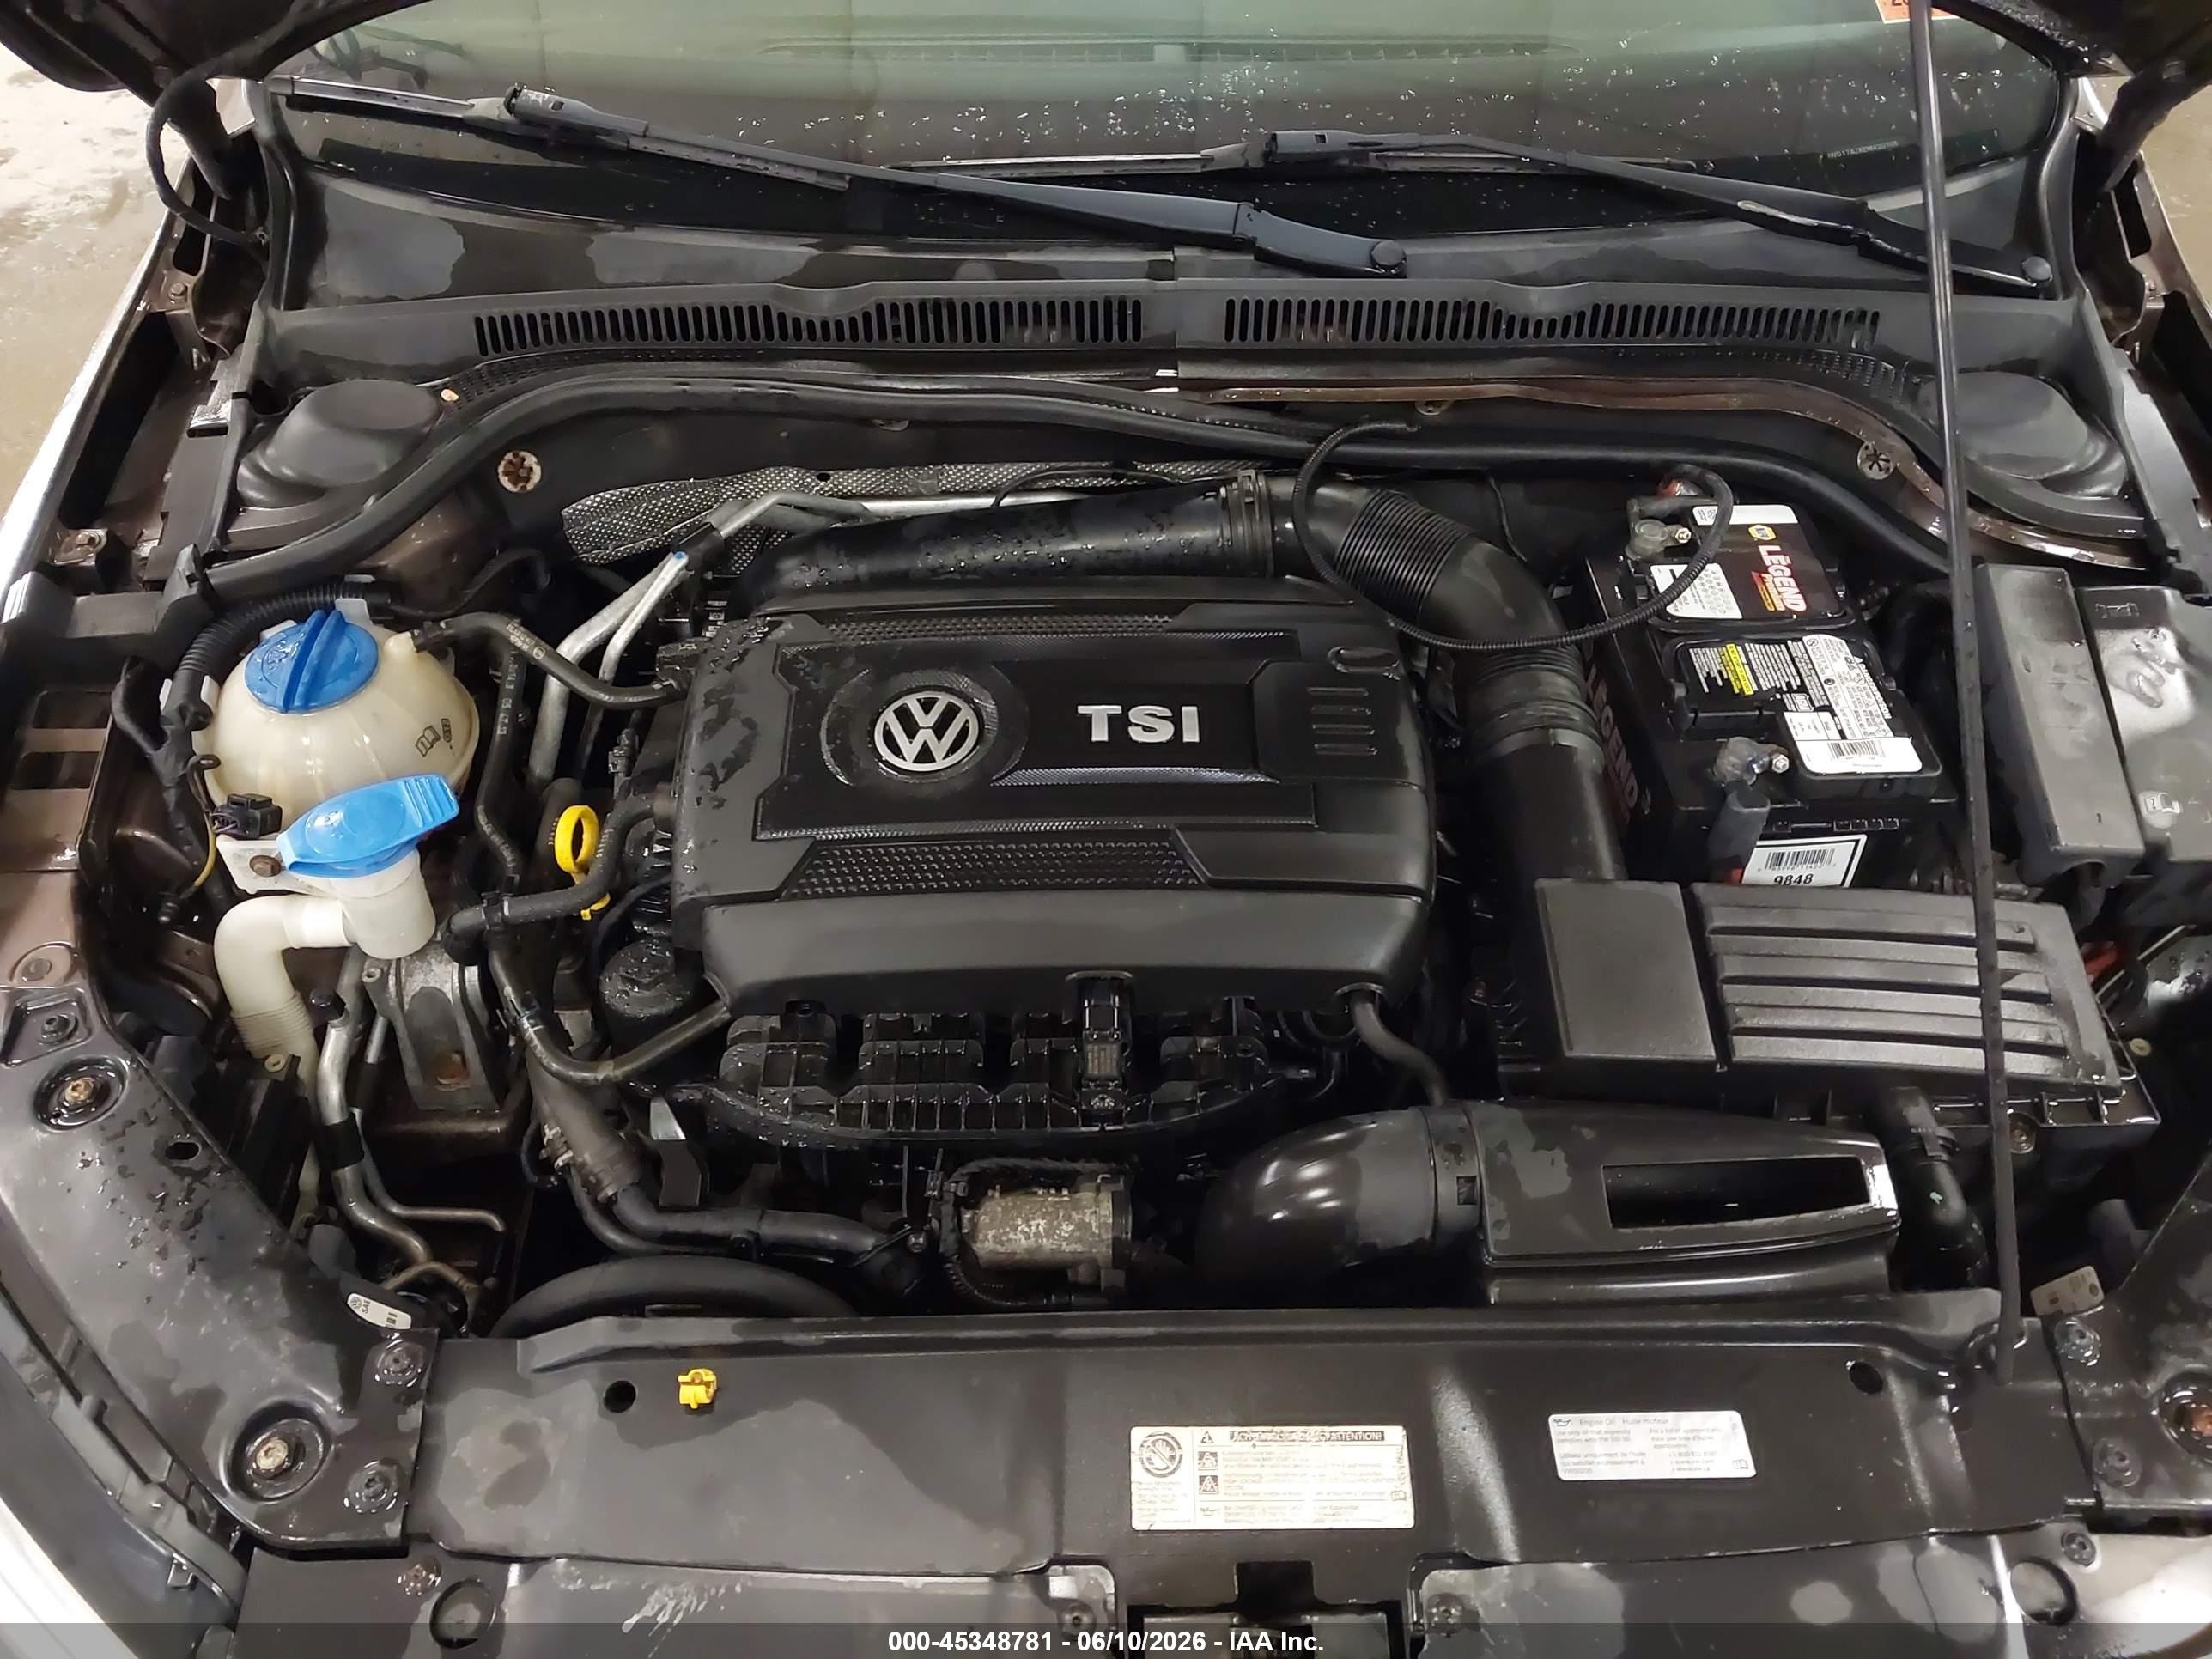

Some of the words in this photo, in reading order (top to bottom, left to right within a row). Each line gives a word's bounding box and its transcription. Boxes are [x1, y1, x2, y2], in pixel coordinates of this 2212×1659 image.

[1077, 705, 1200, 744] TSI
[1773, 872, 1814, 886] 9848
[361, 1299, 372, 1314] SAE
